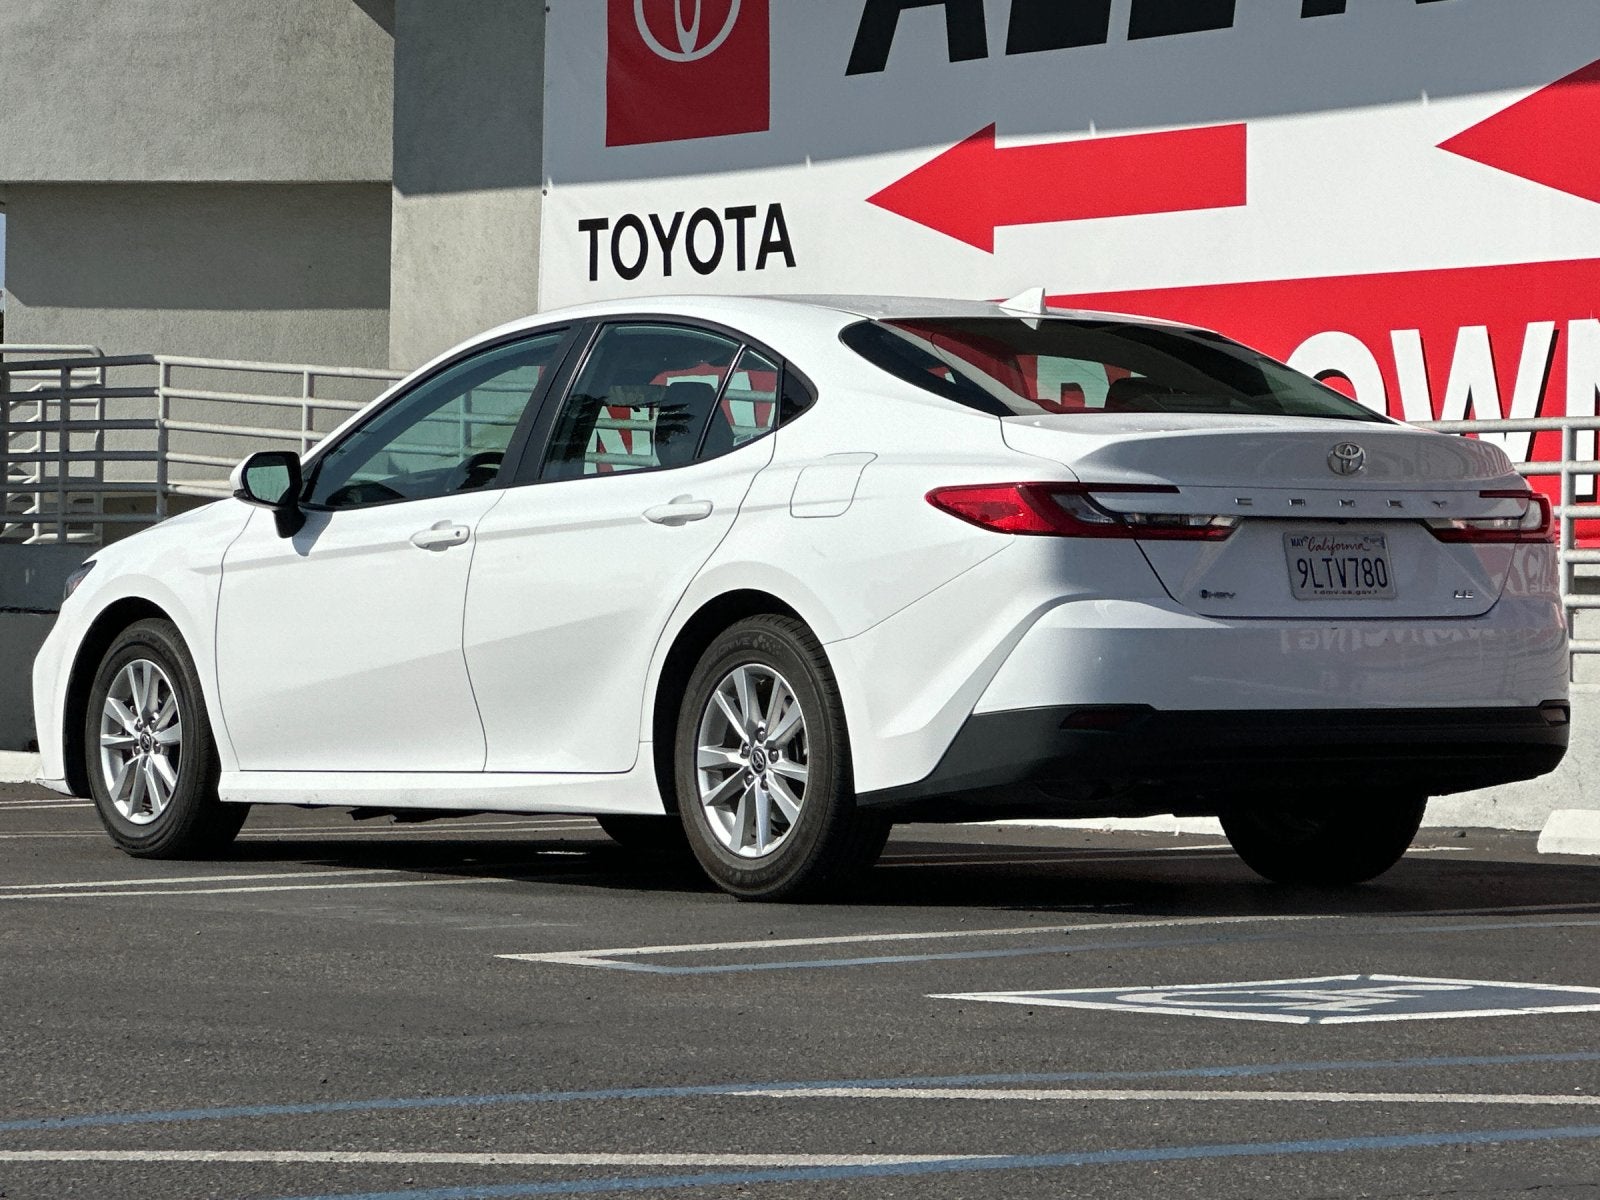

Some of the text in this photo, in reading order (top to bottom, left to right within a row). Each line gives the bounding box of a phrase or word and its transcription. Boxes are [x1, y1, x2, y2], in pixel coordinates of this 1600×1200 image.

[578, 202, 796, 282] TOYOTA
[1234, 497, 1447, 509] CAMRY
[1307, 535, 1371, 556] California
[1296, 557, 1388, 589] 9LTV780
[1453, 589, 1475, 599] LE
